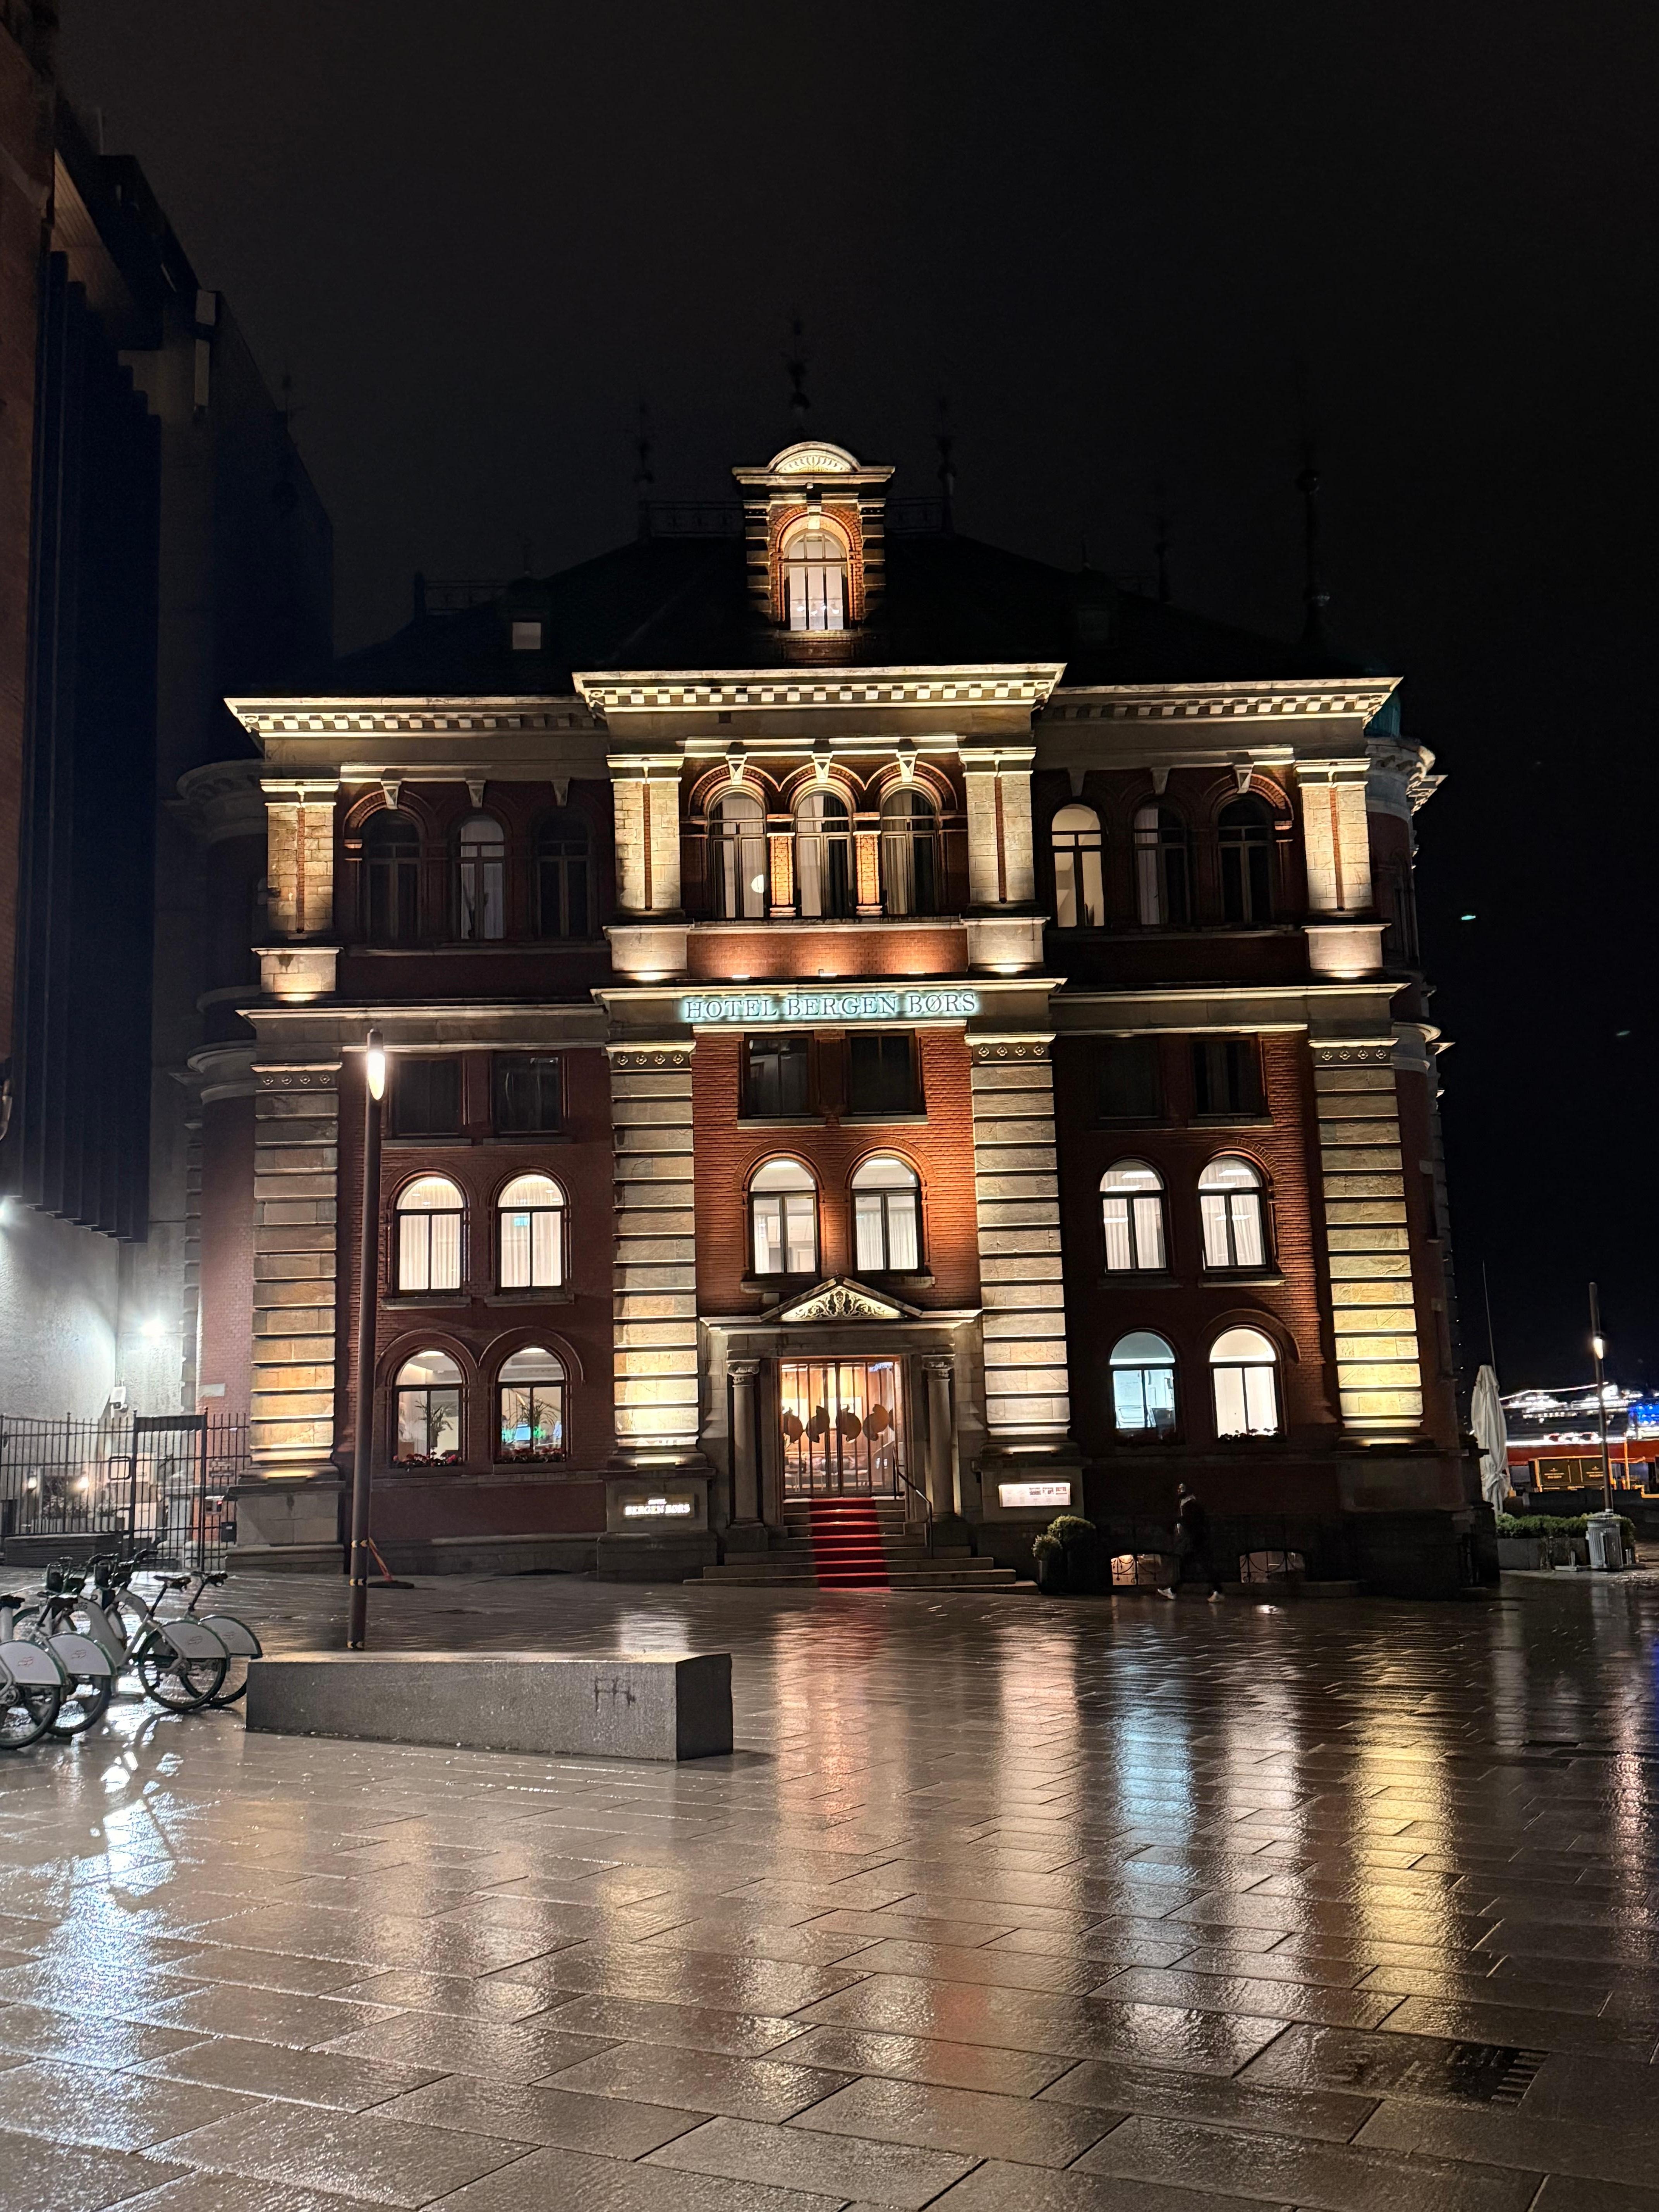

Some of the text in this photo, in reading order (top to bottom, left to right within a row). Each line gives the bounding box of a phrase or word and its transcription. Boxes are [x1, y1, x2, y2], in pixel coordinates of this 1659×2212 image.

[685, 994, 975, 1018] HOTEL BERGEN BØRS
